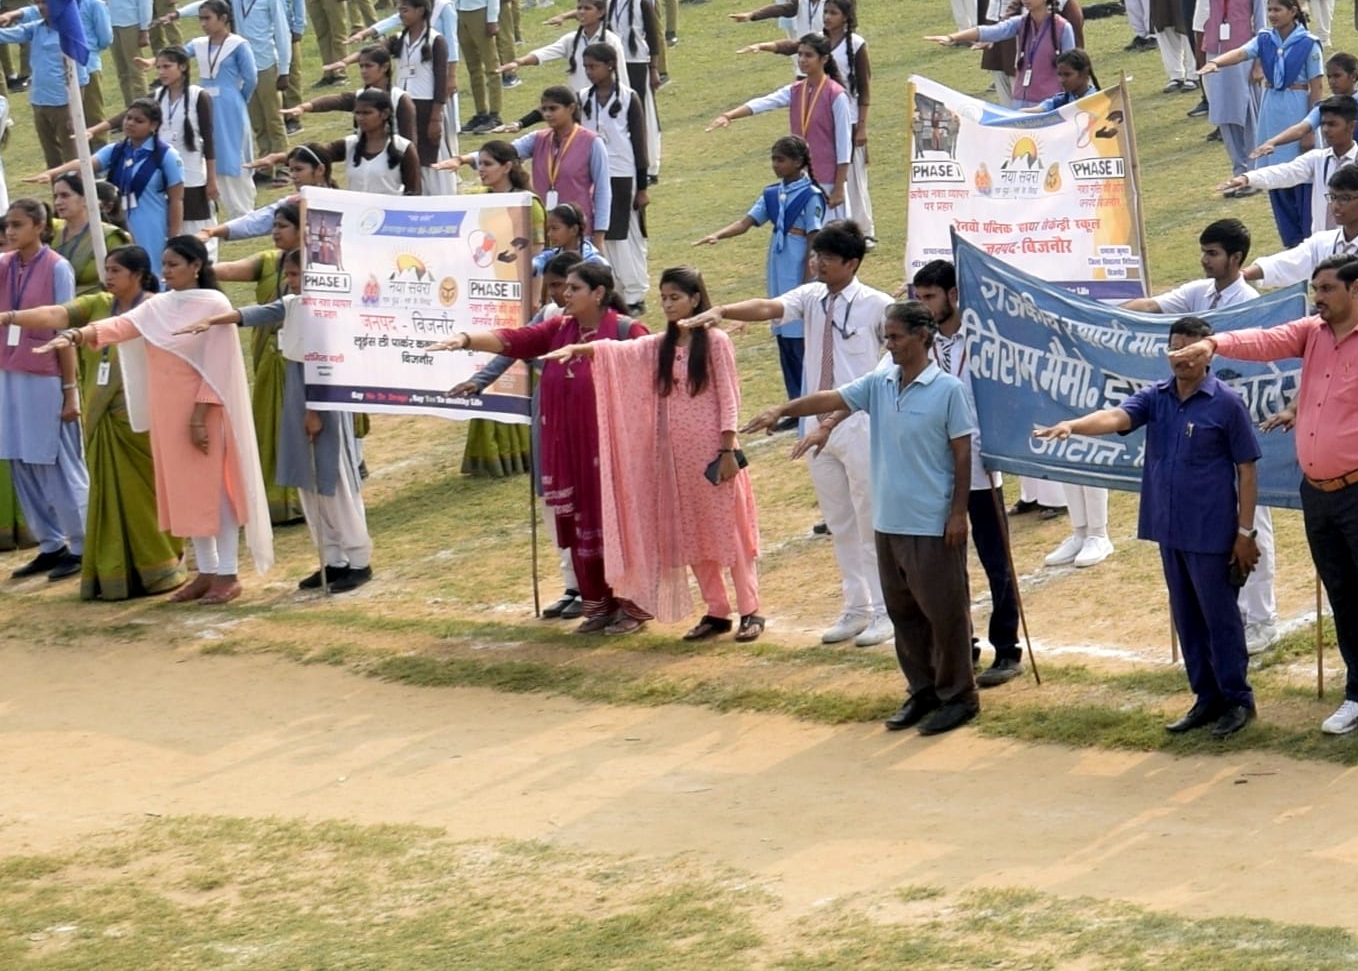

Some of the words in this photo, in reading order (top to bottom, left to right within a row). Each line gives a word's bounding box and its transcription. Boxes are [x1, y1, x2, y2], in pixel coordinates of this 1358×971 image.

[913, 165, 953, 177] PHASE
[1072, 161, 1112, 176] PHASE
[1115, 160, 1123, 174] II
[304, 275, 340, 288] PHASE
[470, 282, 508, 297] PHASE
[512, 284, 520, 297] II
[360, 314, 399, 331] जनपद
[412, 310, 457, 335] बिजनौर
[962, 307, 1044, 392] दिलेराम
